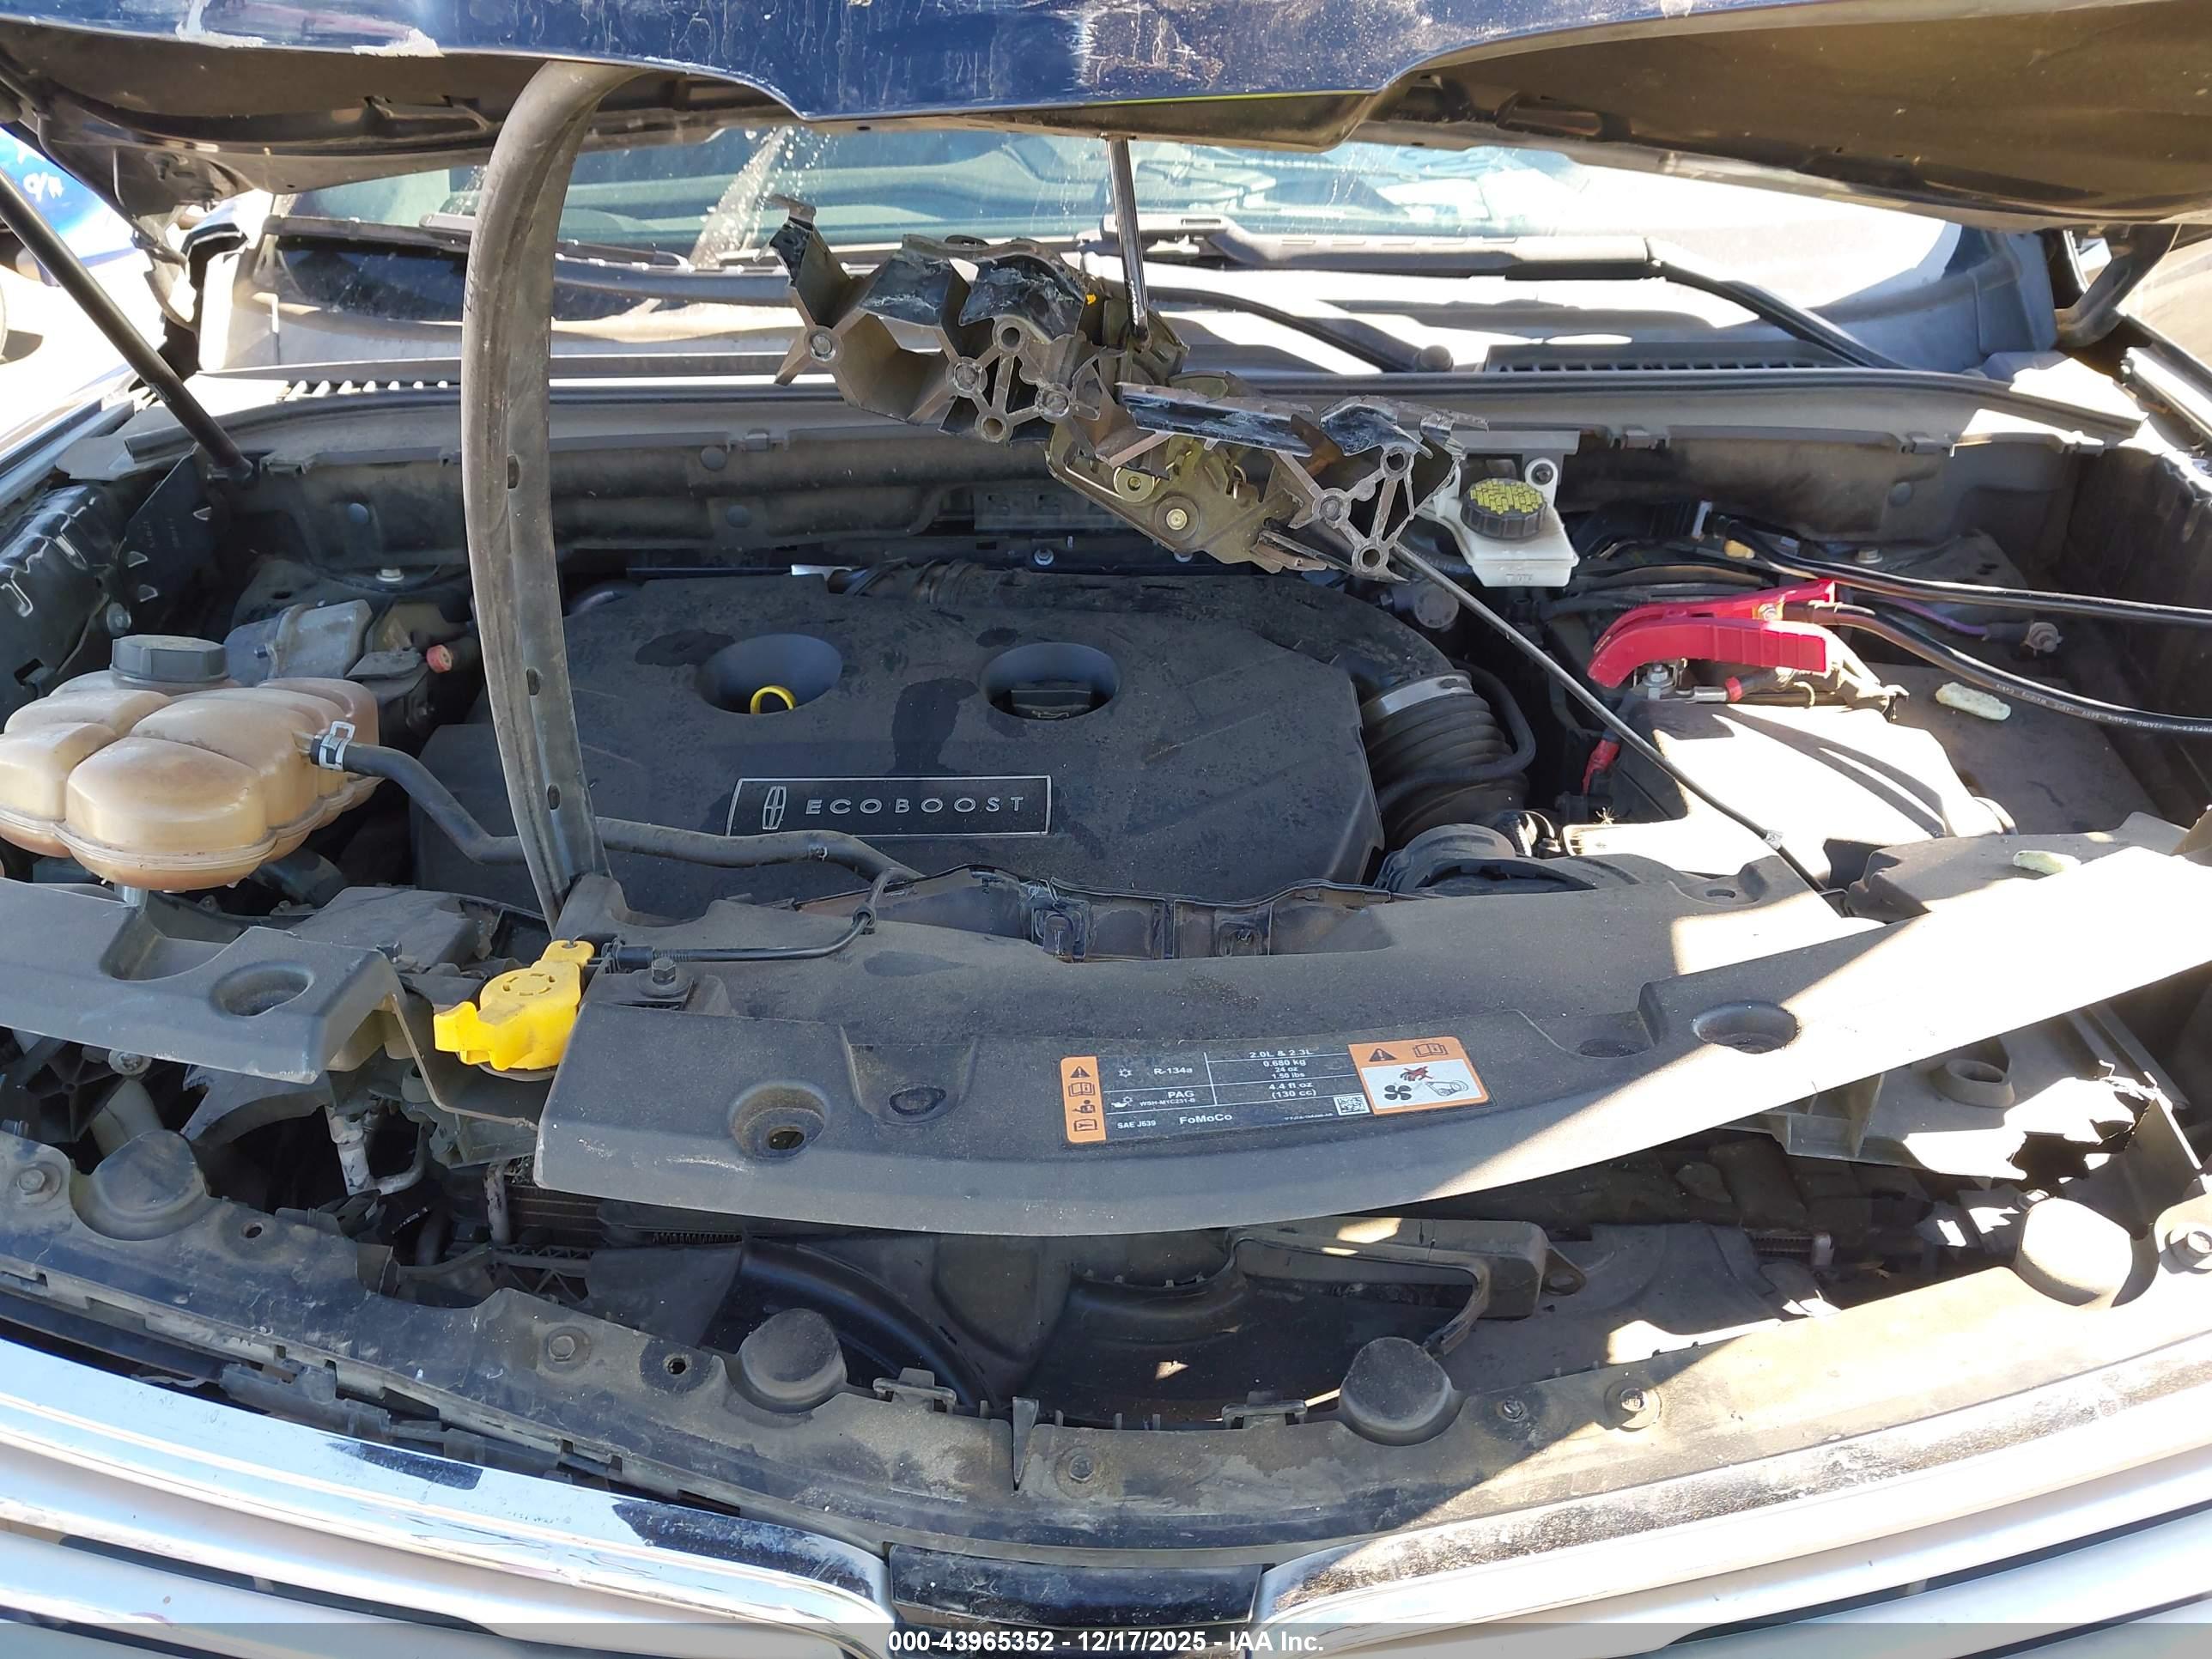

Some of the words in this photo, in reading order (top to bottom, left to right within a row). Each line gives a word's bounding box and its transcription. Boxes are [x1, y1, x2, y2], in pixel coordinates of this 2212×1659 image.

[805, 796, 1024, 815] ECOBOOST
[1292, 1059, 1307, 1067] kg
[1153, 1066, 1193, 1075] R-134a
[1168, 1090, 1195, 1099] PAG
[1272, 1091, 1296, 1099] (130
[1179, 1113, 1233, 1125] FoMoCo
